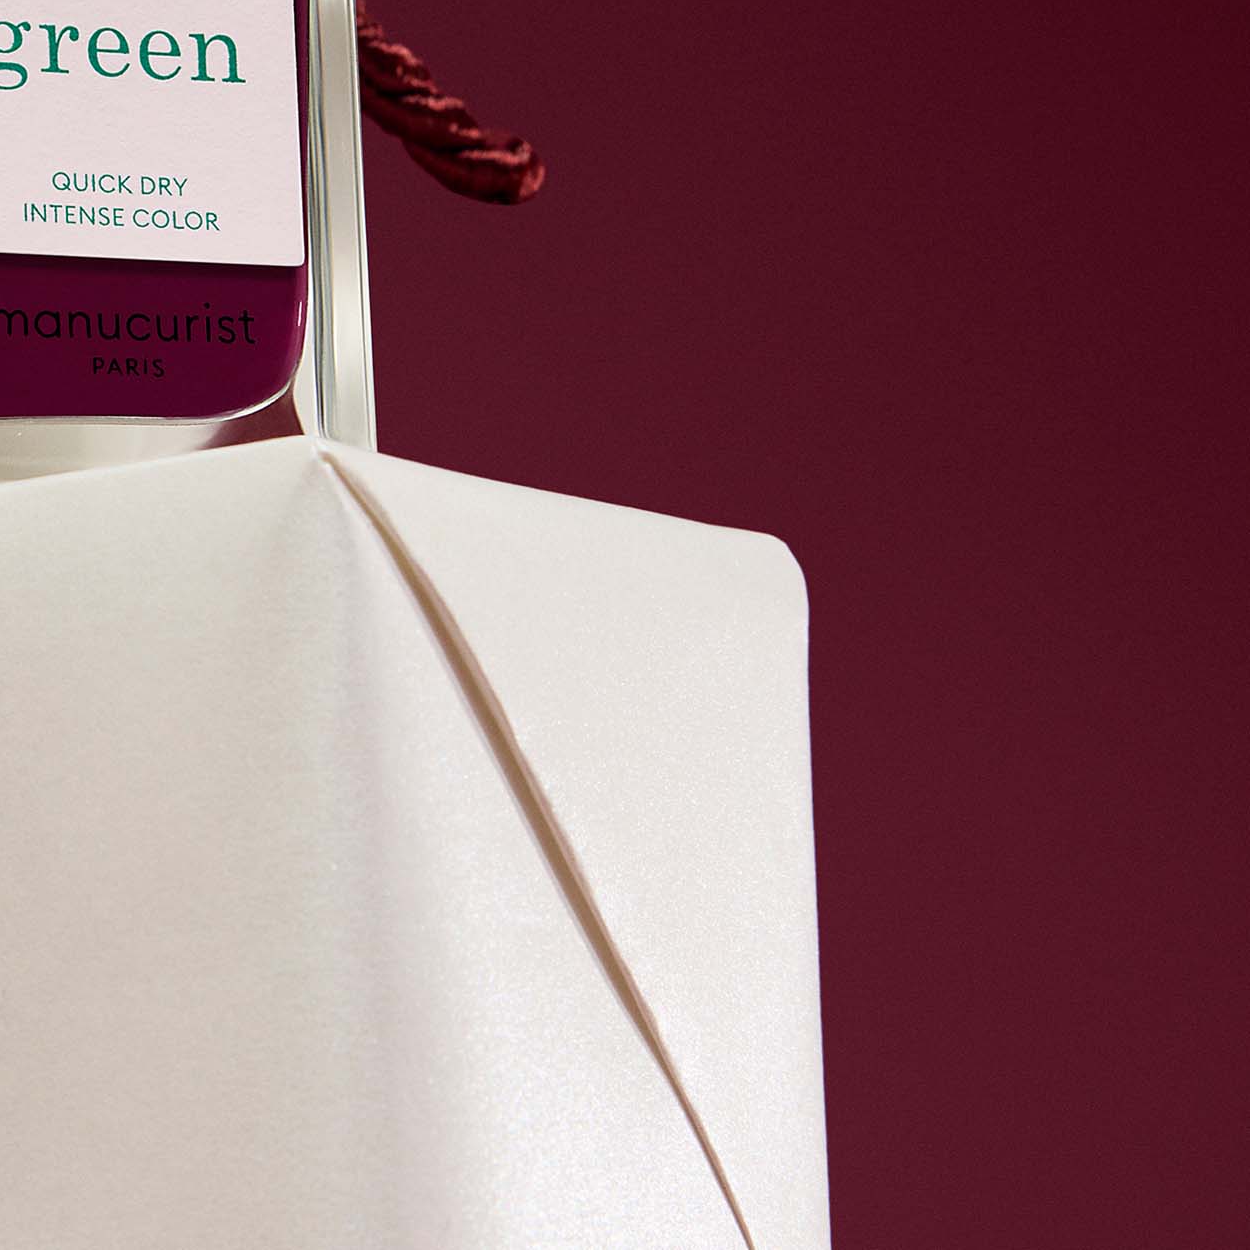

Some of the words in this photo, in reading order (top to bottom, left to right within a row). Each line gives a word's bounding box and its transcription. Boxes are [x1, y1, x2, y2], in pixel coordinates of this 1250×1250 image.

[51, 171, 134, 195] QUICK
[140, 175, 188, 197] DRY
[23, 202, 125, 227] INTENSE
[132, 208, 220, 232] COLOR
[92, 356, 166, 379] PARIS
